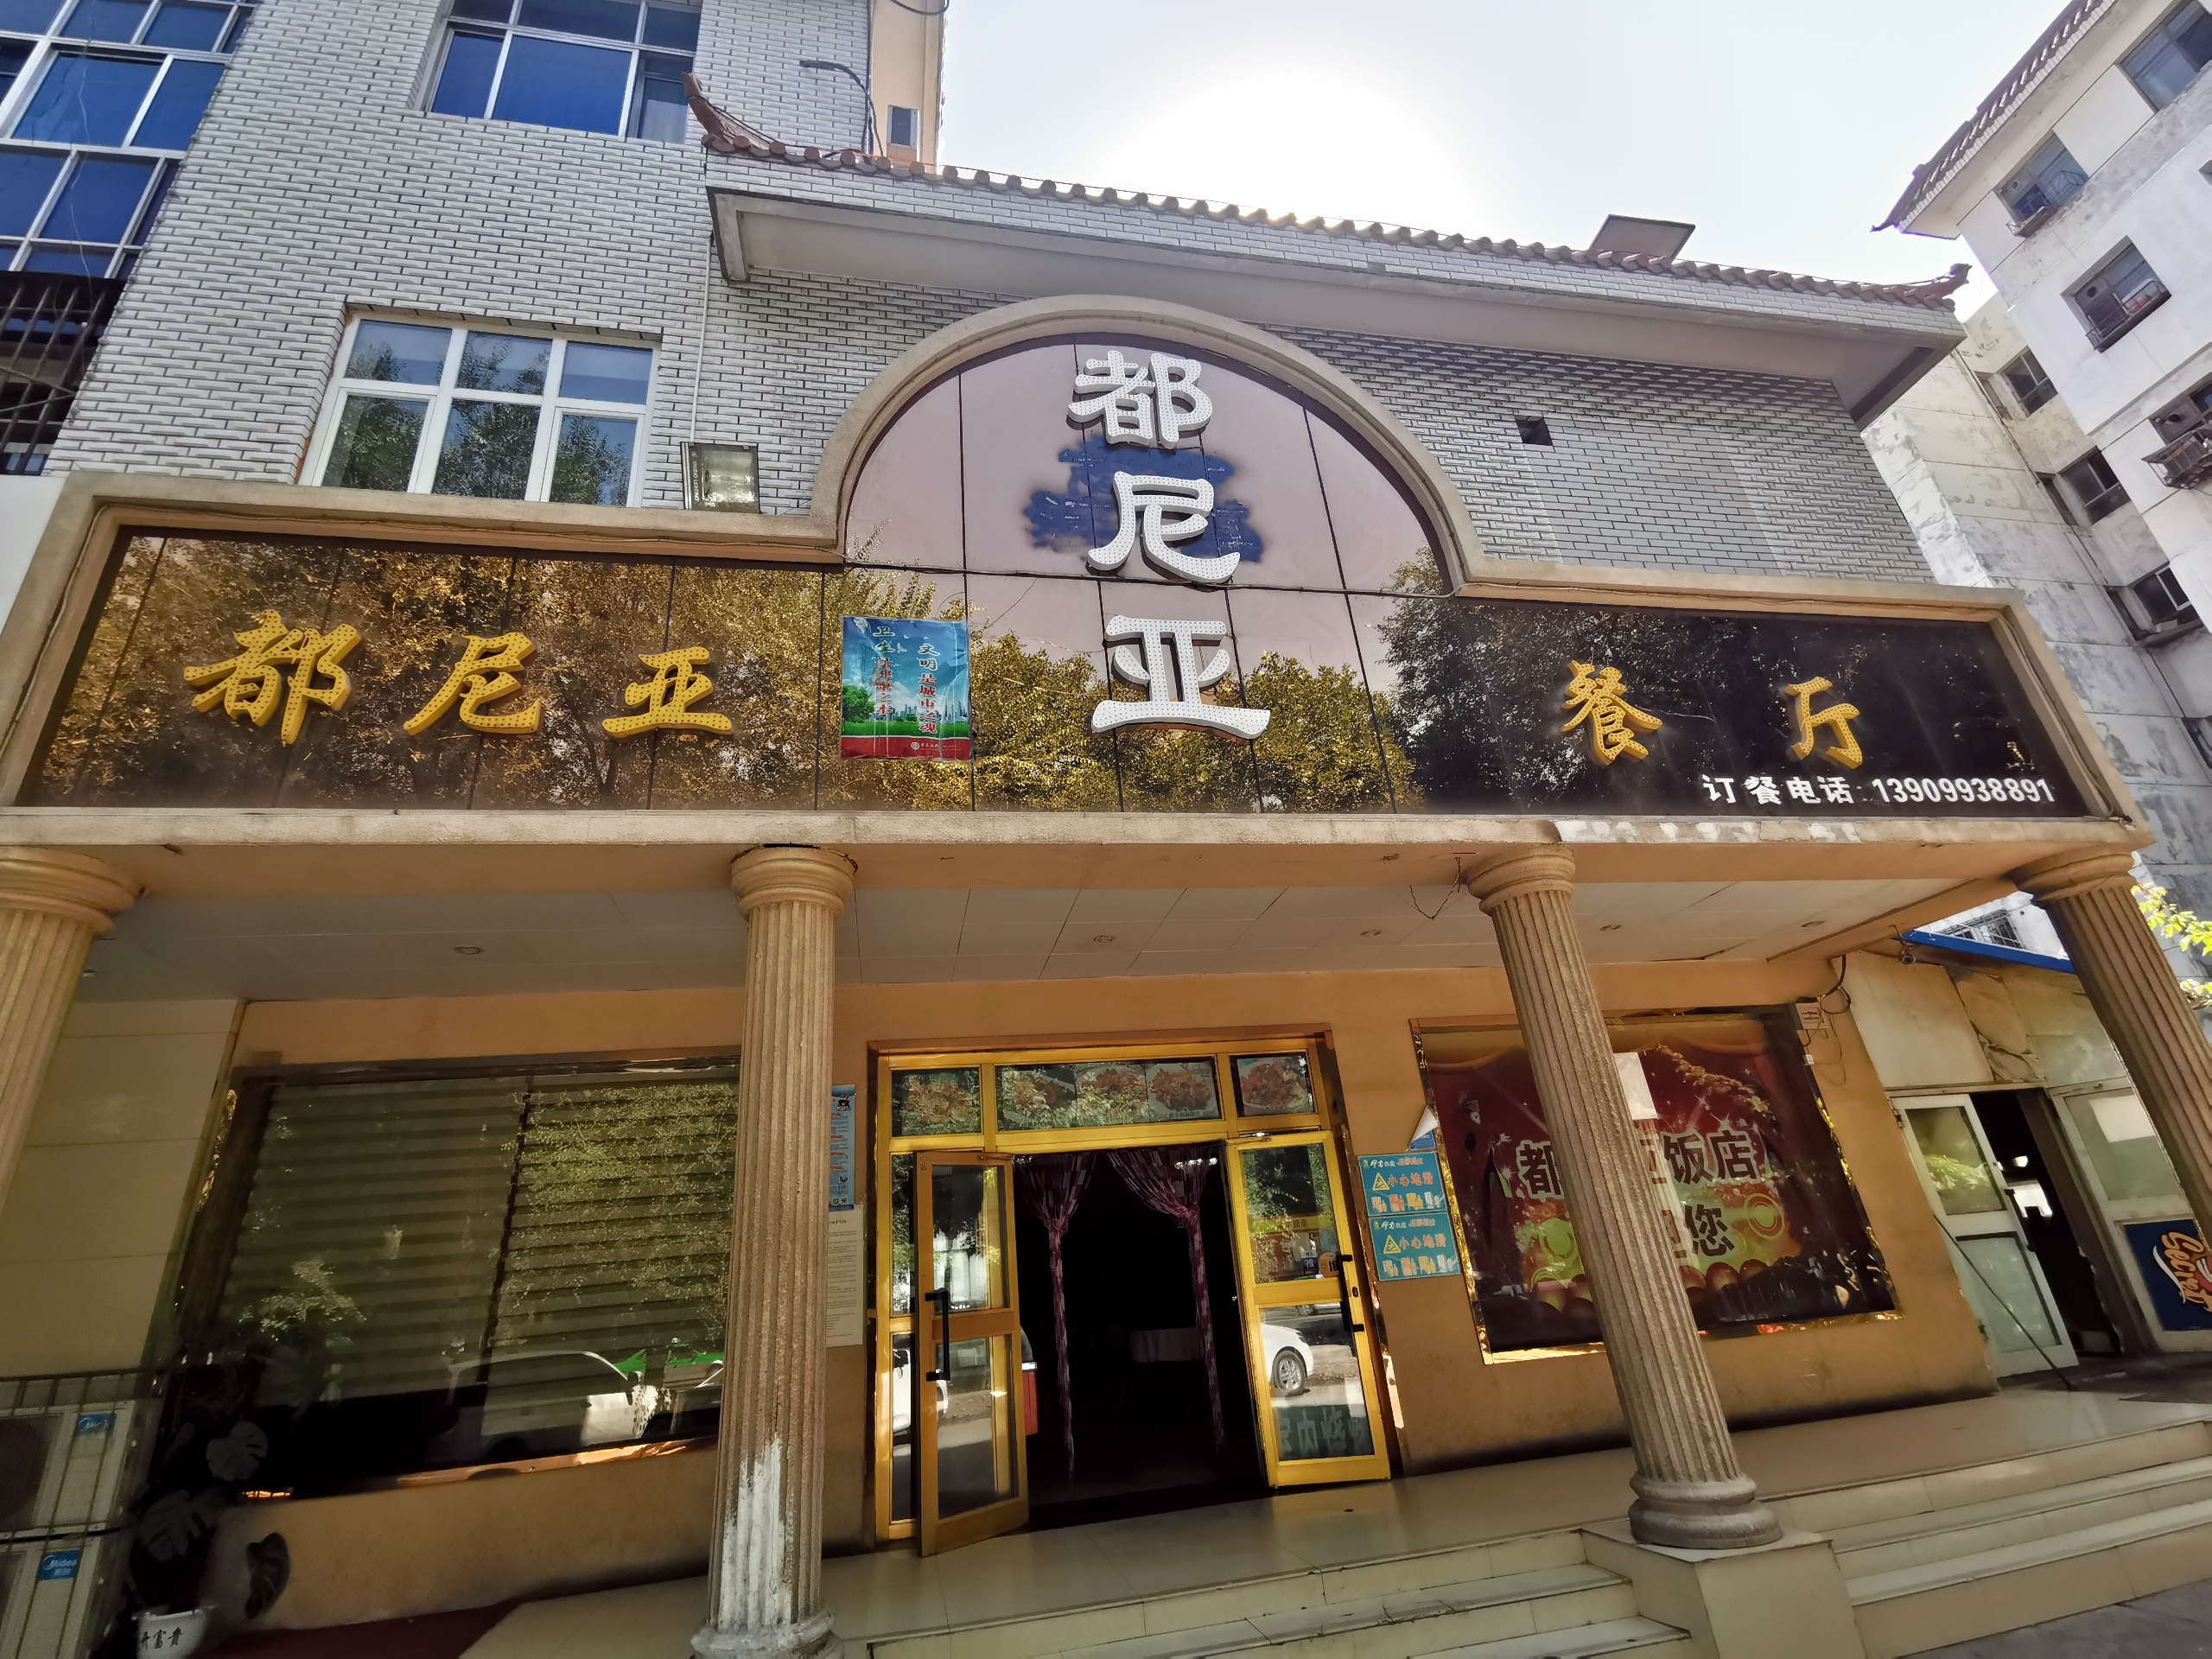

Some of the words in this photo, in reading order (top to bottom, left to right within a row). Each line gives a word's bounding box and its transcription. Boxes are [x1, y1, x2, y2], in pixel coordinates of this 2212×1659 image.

[1066, 349, 1271, 740] 都尼亚
[183, 608, 733, 745] 都尼亚
[1560, 659, 1864, 768] 餐厅
[918, 643, 940, 734] 文明是城市之魂
[1872, 778, 2056, 804] 13909938891
[1388, 1172, 1434, 1187] 小心地滑
[1518, 1128, 1758, 1196] 都饭店
[1399, 1233, 1446, 1250] 小心地滑
